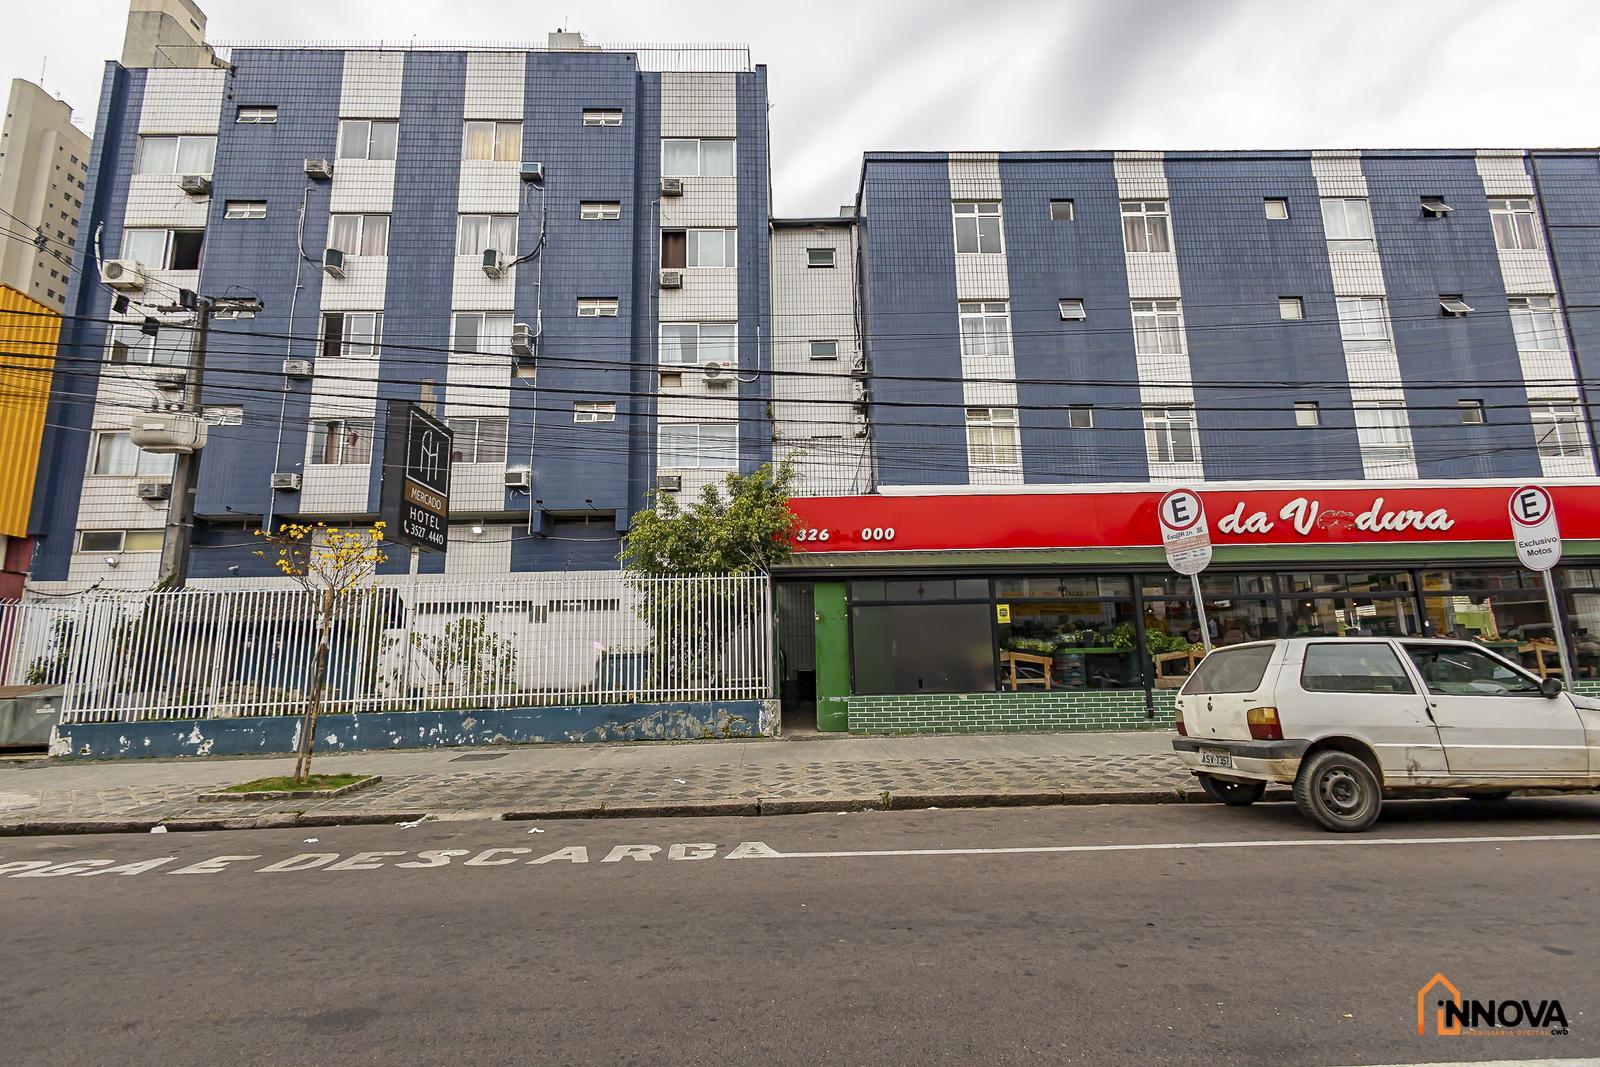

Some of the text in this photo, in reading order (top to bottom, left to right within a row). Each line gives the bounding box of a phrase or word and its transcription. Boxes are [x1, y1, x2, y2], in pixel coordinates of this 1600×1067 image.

[410, 487, 442, 510] MERCADO
[1171, 496, 1190, 523] E
[1520, 492, 1540, 518] E
[409, 506, 440, 530] HOTEL
[1217, 501, 1275, 534] da
[796, 527, 895, 542] 326 000
[1519, 537, 1557, 548] Exclusivo
[1527, 548, 1552, 556] Motos
[166, 854, 262, 875] E
[254, 841, 783, 873] DESCARGA
